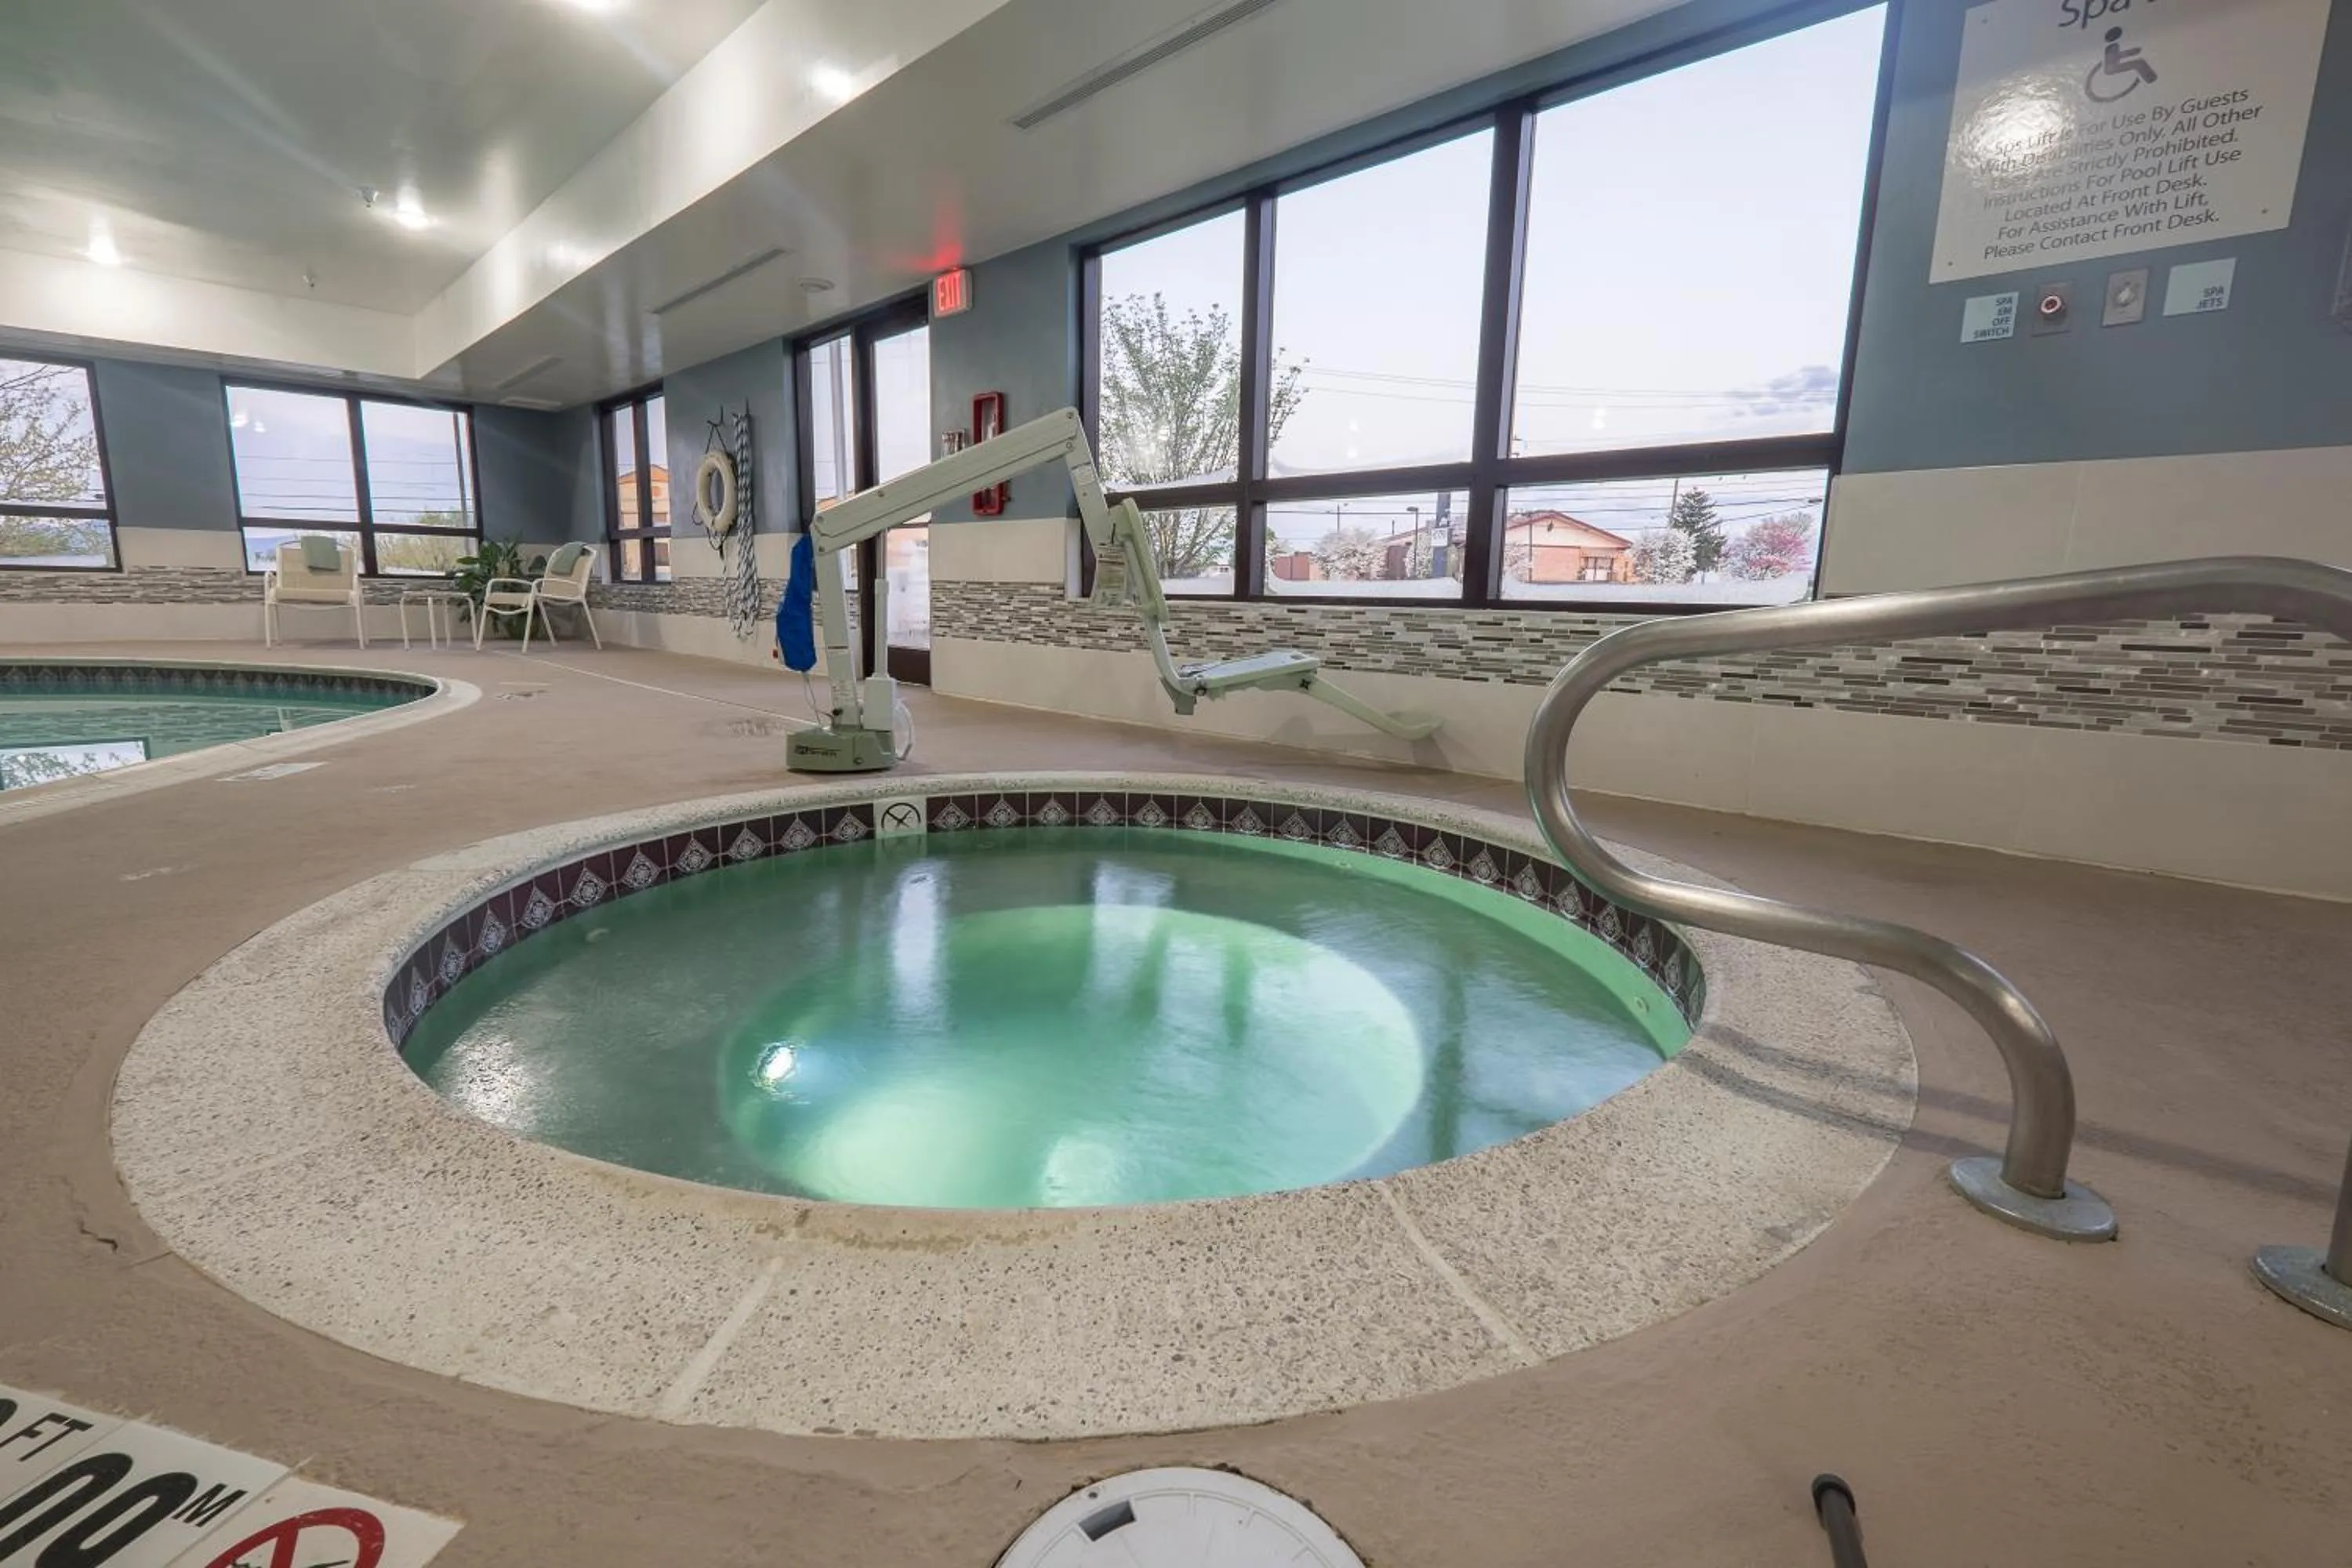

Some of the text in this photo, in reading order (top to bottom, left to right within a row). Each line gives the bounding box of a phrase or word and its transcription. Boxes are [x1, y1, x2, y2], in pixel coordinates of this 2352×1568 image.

[2078, 122, 2107, 136] For
[2111, 112, 2146, 129] Use
[2152, 106, 2176, 122] By
[2180, 89, 2249, 114] Guests
[2171, 116, 2198, 136] All
[2202, 105, 2264, 129] Other
[2067, 151, 2129, 174] Strictly
[2133, 127, 2238, 162] Prohibited.
[1984, 149, 2241, 210] Instructions For Pool Lift Use
[2004, 172, 2207, 223] Located At Front Desk.
[1984, 209, 2220, 260] Please Contact Front Desk.
[1997, 226, 2024, 240] For
[2028, 209, 2119, 234] Assistance
[2125, 199, 2168, 218] With
[937, 272, 960, 311] EXIT
[1995, 296, 2013, 307] SPA
[2197, 298, 2223, 310] JETS
[2204, 285, 2224, 298] SPA
[0, 1413, 94, 1461] FT
